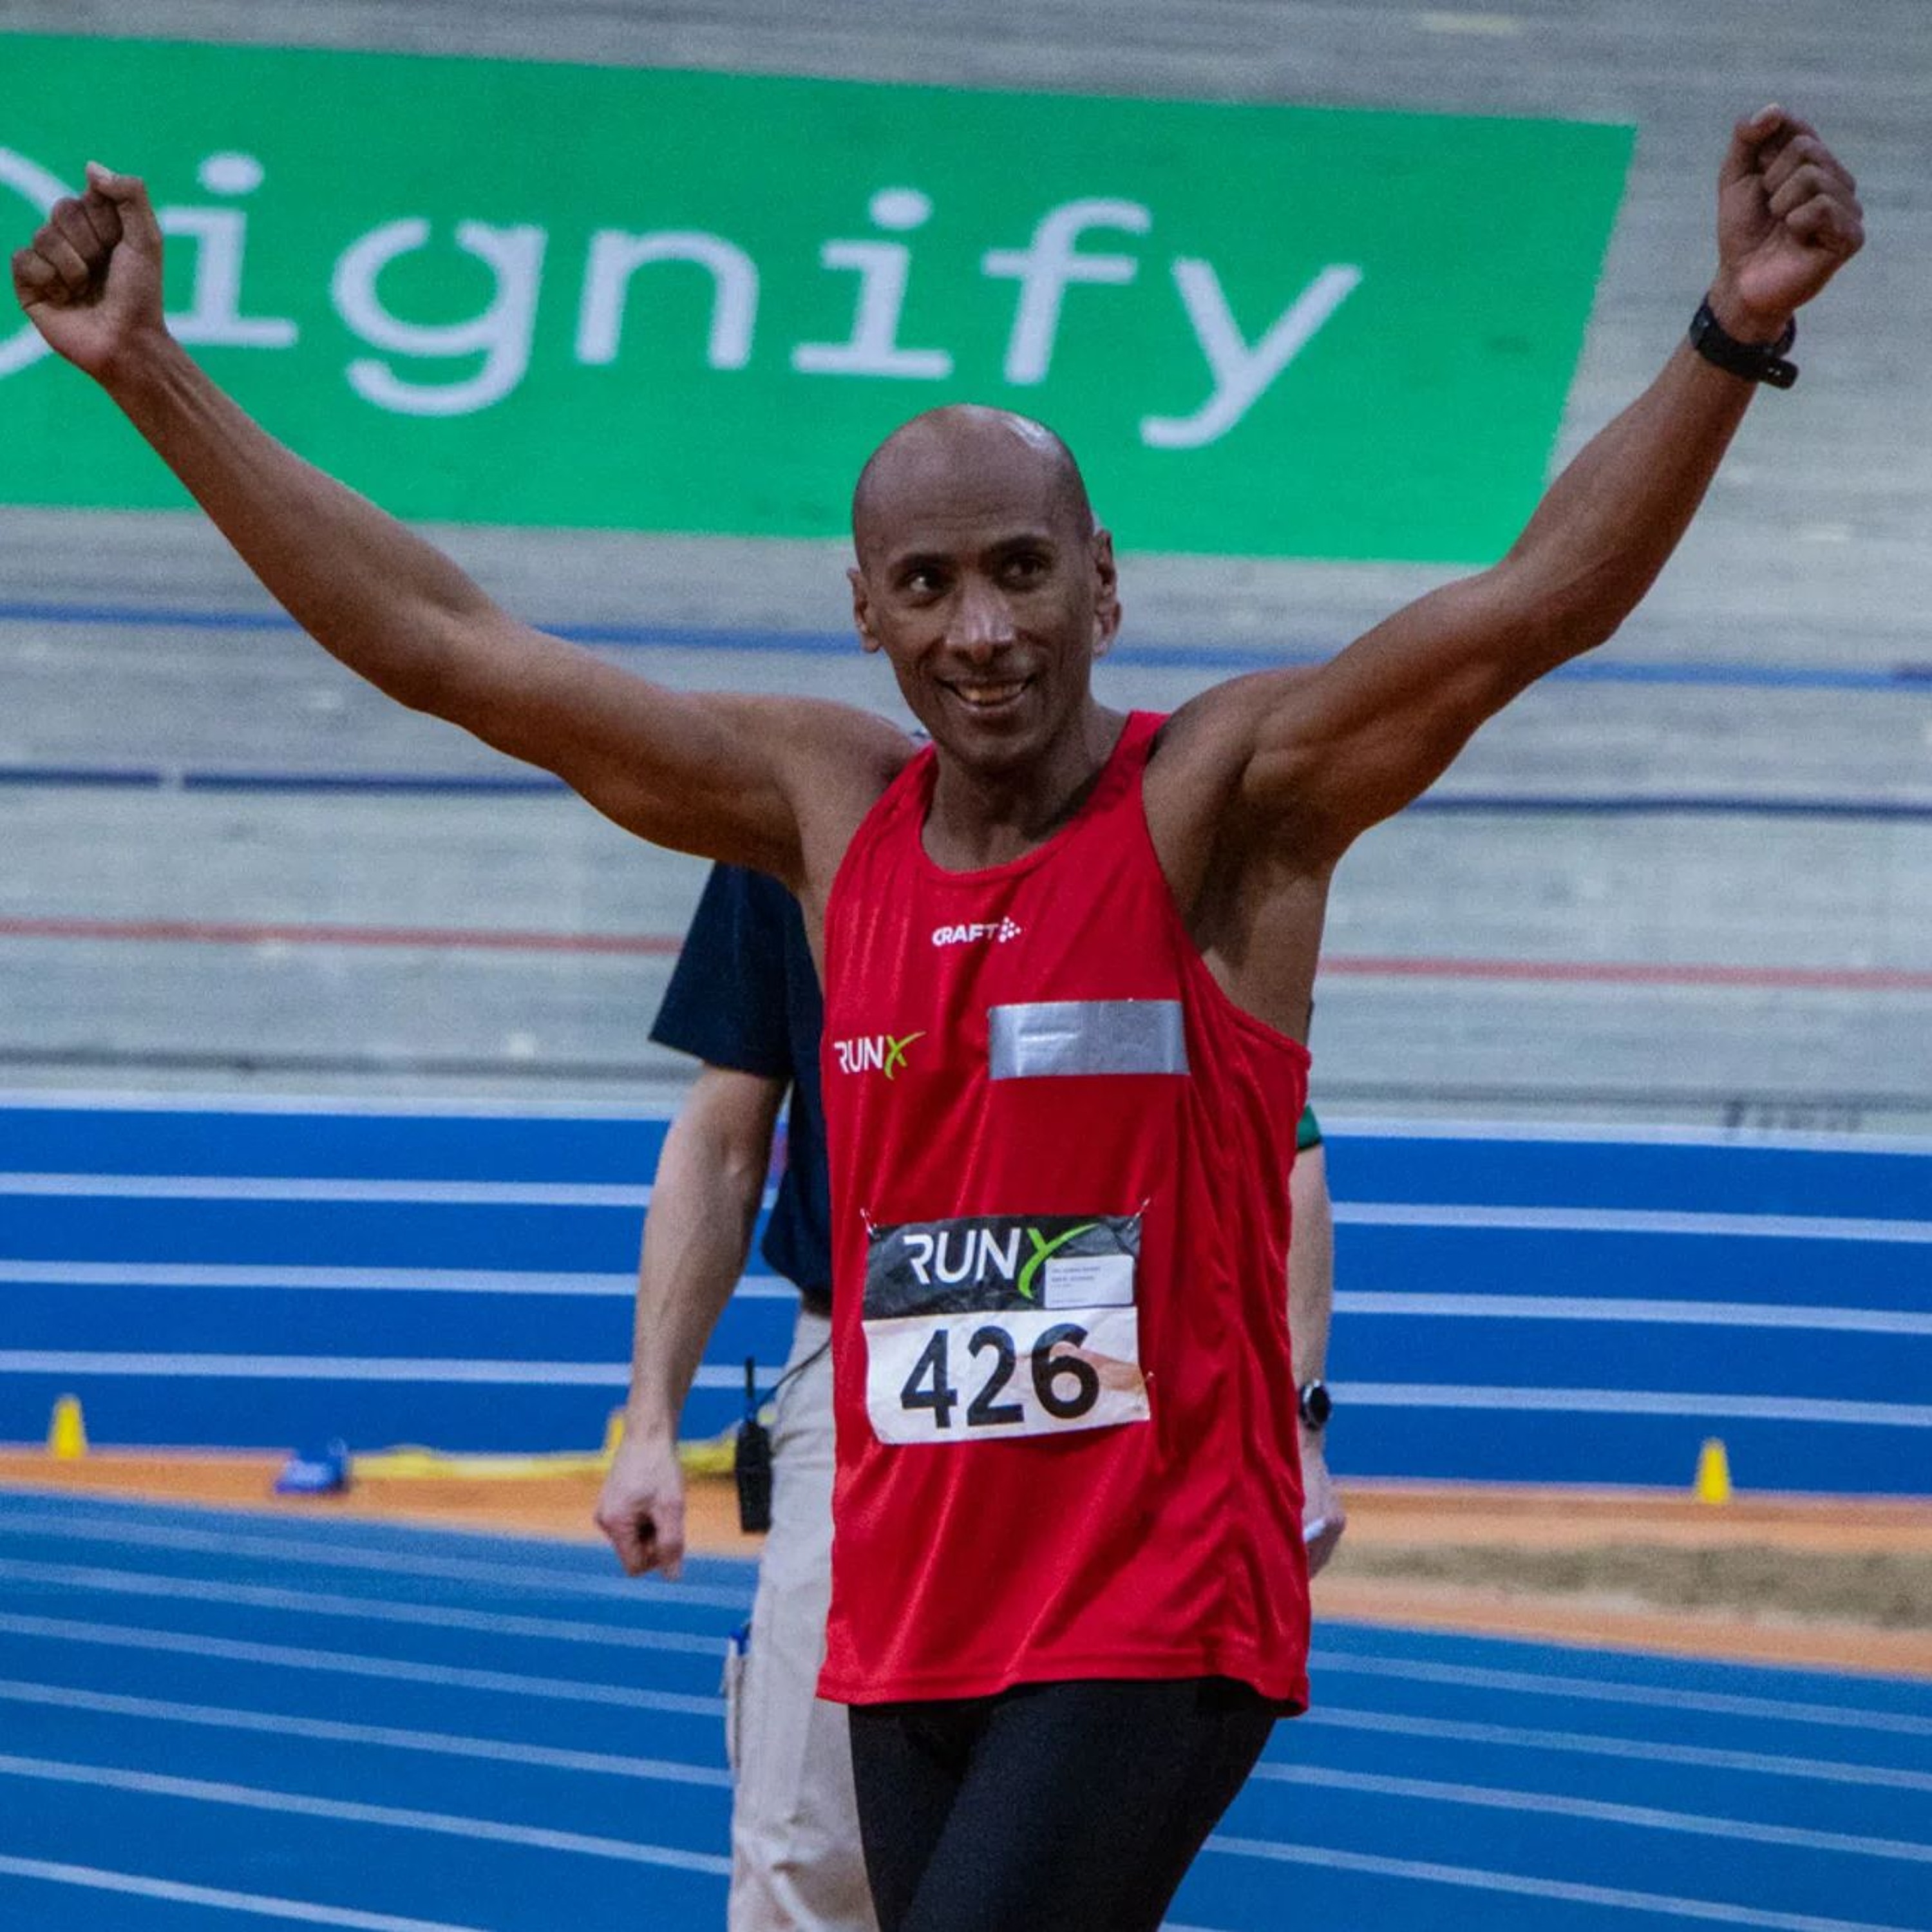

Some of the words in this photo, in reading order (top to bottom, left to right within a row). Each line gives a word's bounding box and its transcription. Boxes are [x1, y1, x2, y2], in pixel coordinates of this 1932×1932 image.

[932, 923, 999, 946] CRAFT
[835, 1032, 926, 1079] RUNX
[900, 1323, 1099, 1429] 426
